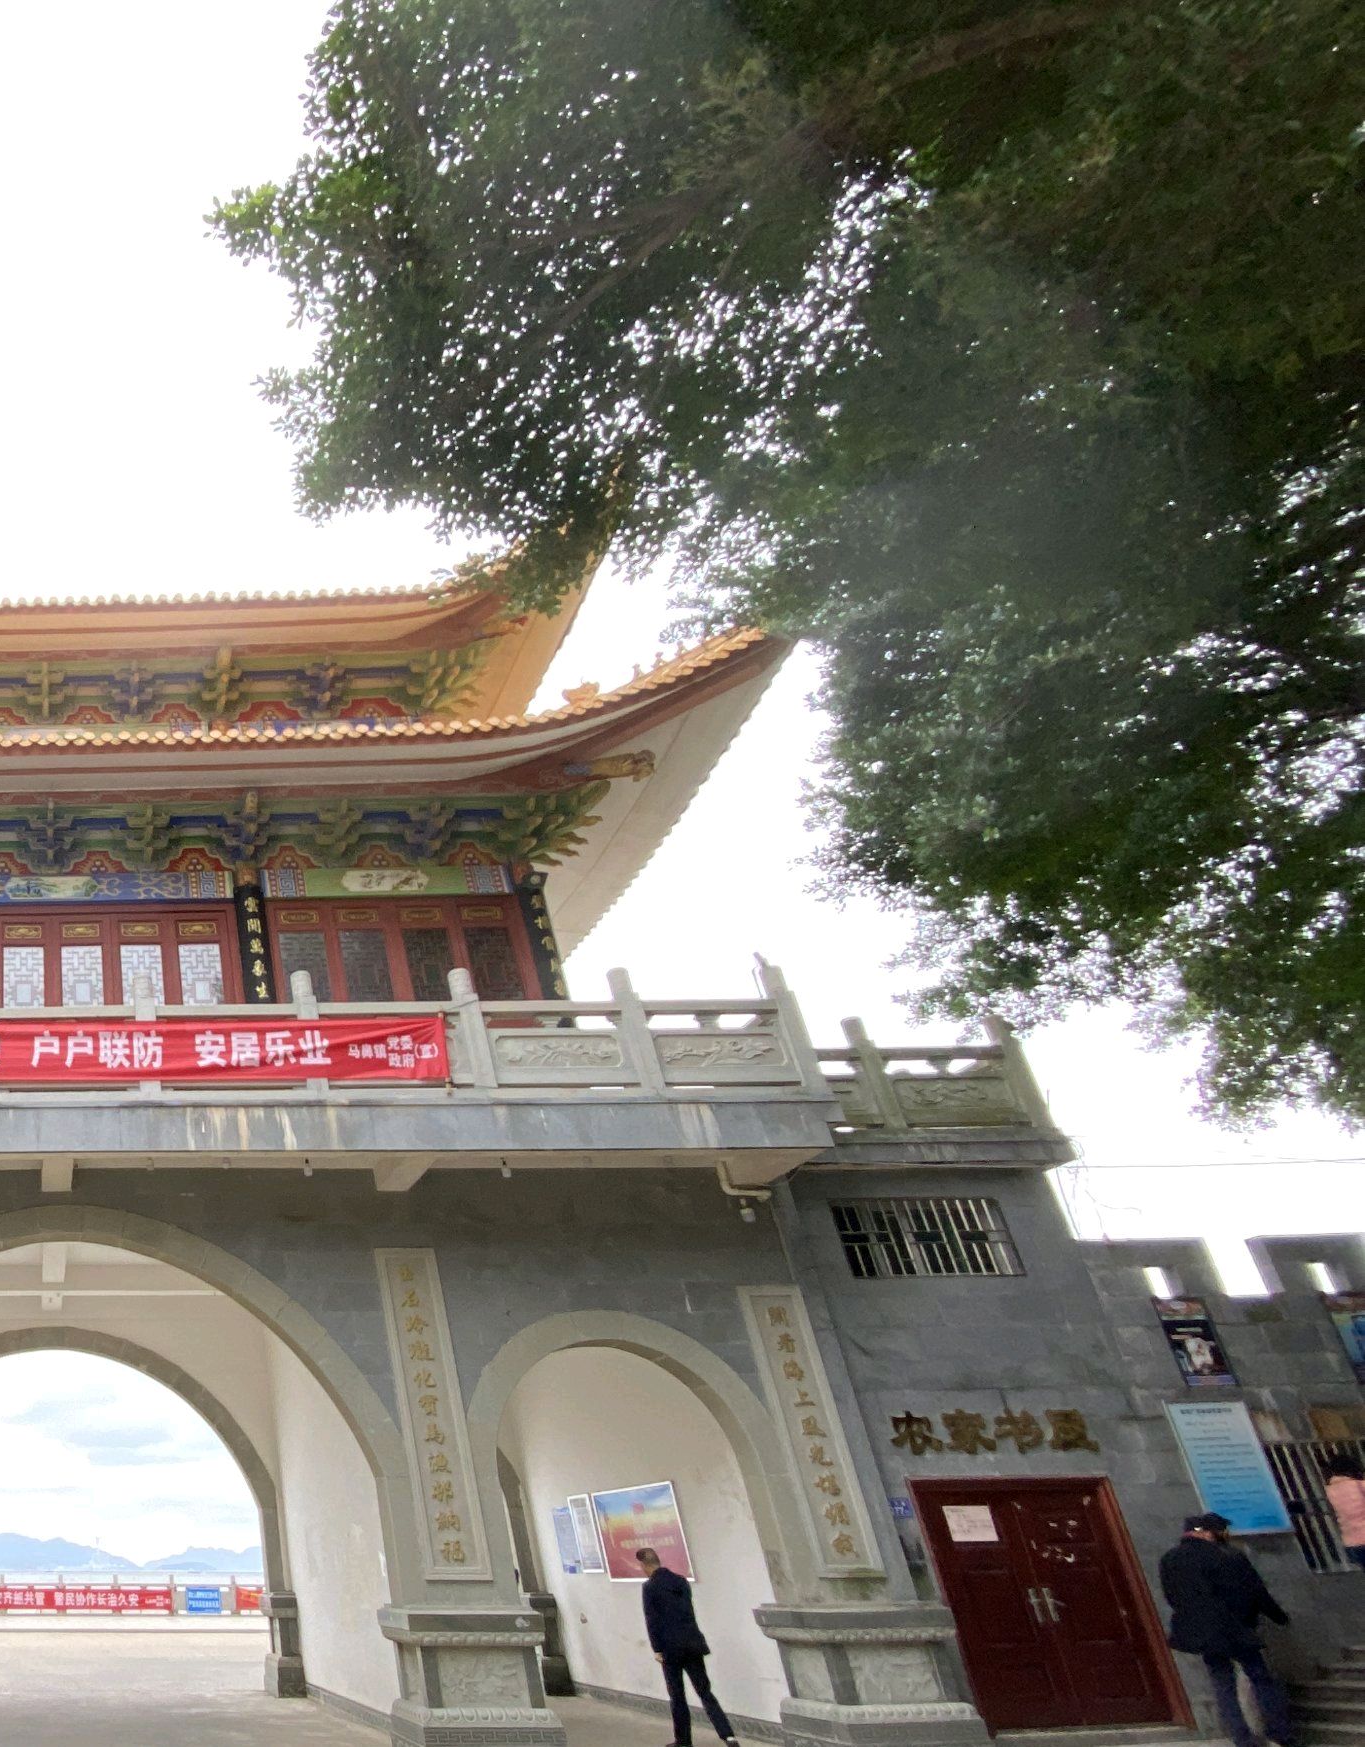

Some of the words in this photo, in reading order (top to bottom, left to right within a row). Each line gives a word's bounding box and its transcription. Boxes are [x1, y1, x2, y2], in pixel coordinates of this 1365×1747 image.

[30, 1029, 164, 1069] 户户联防
[194, 1029, 332, 1068] 安居乐业
[890, 1408, 1101, 1456] 农家书屋
